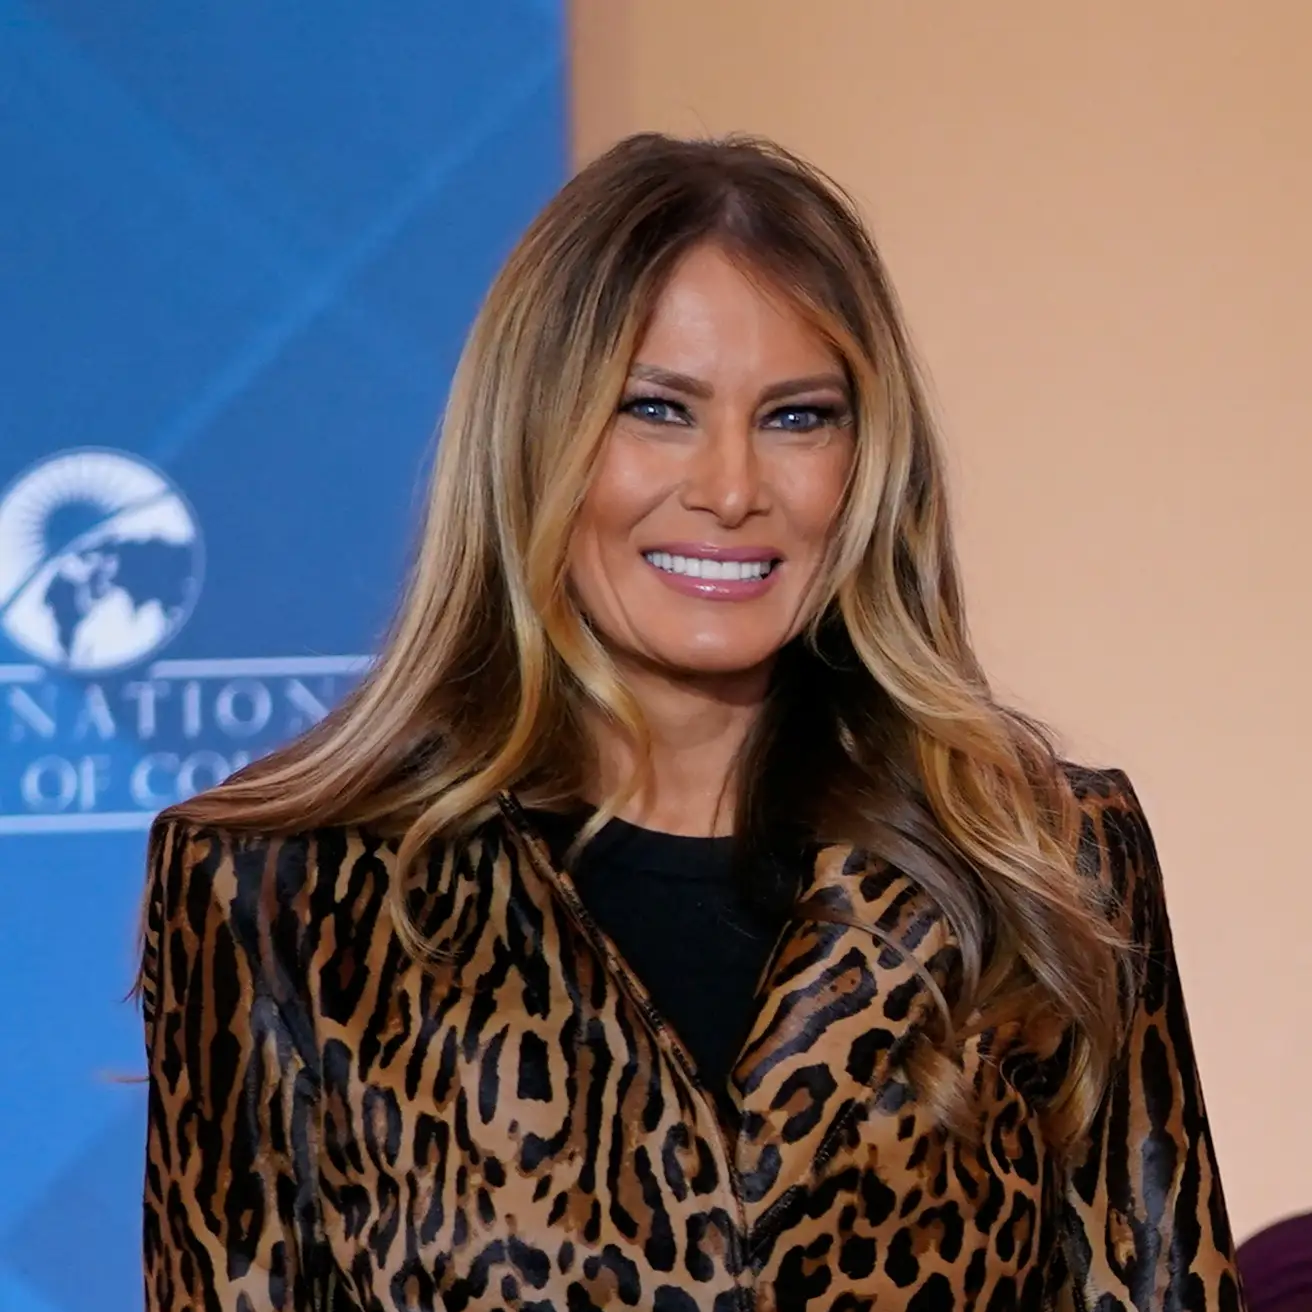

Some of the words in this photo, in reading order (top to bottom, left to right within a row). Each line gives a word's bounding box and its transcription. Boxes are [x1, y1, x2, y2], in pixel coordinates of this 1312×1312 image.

[8, 677, 338, 742] NATION
[20, 754, 111, 812] OF
[130, 751, 250, 810] CO
